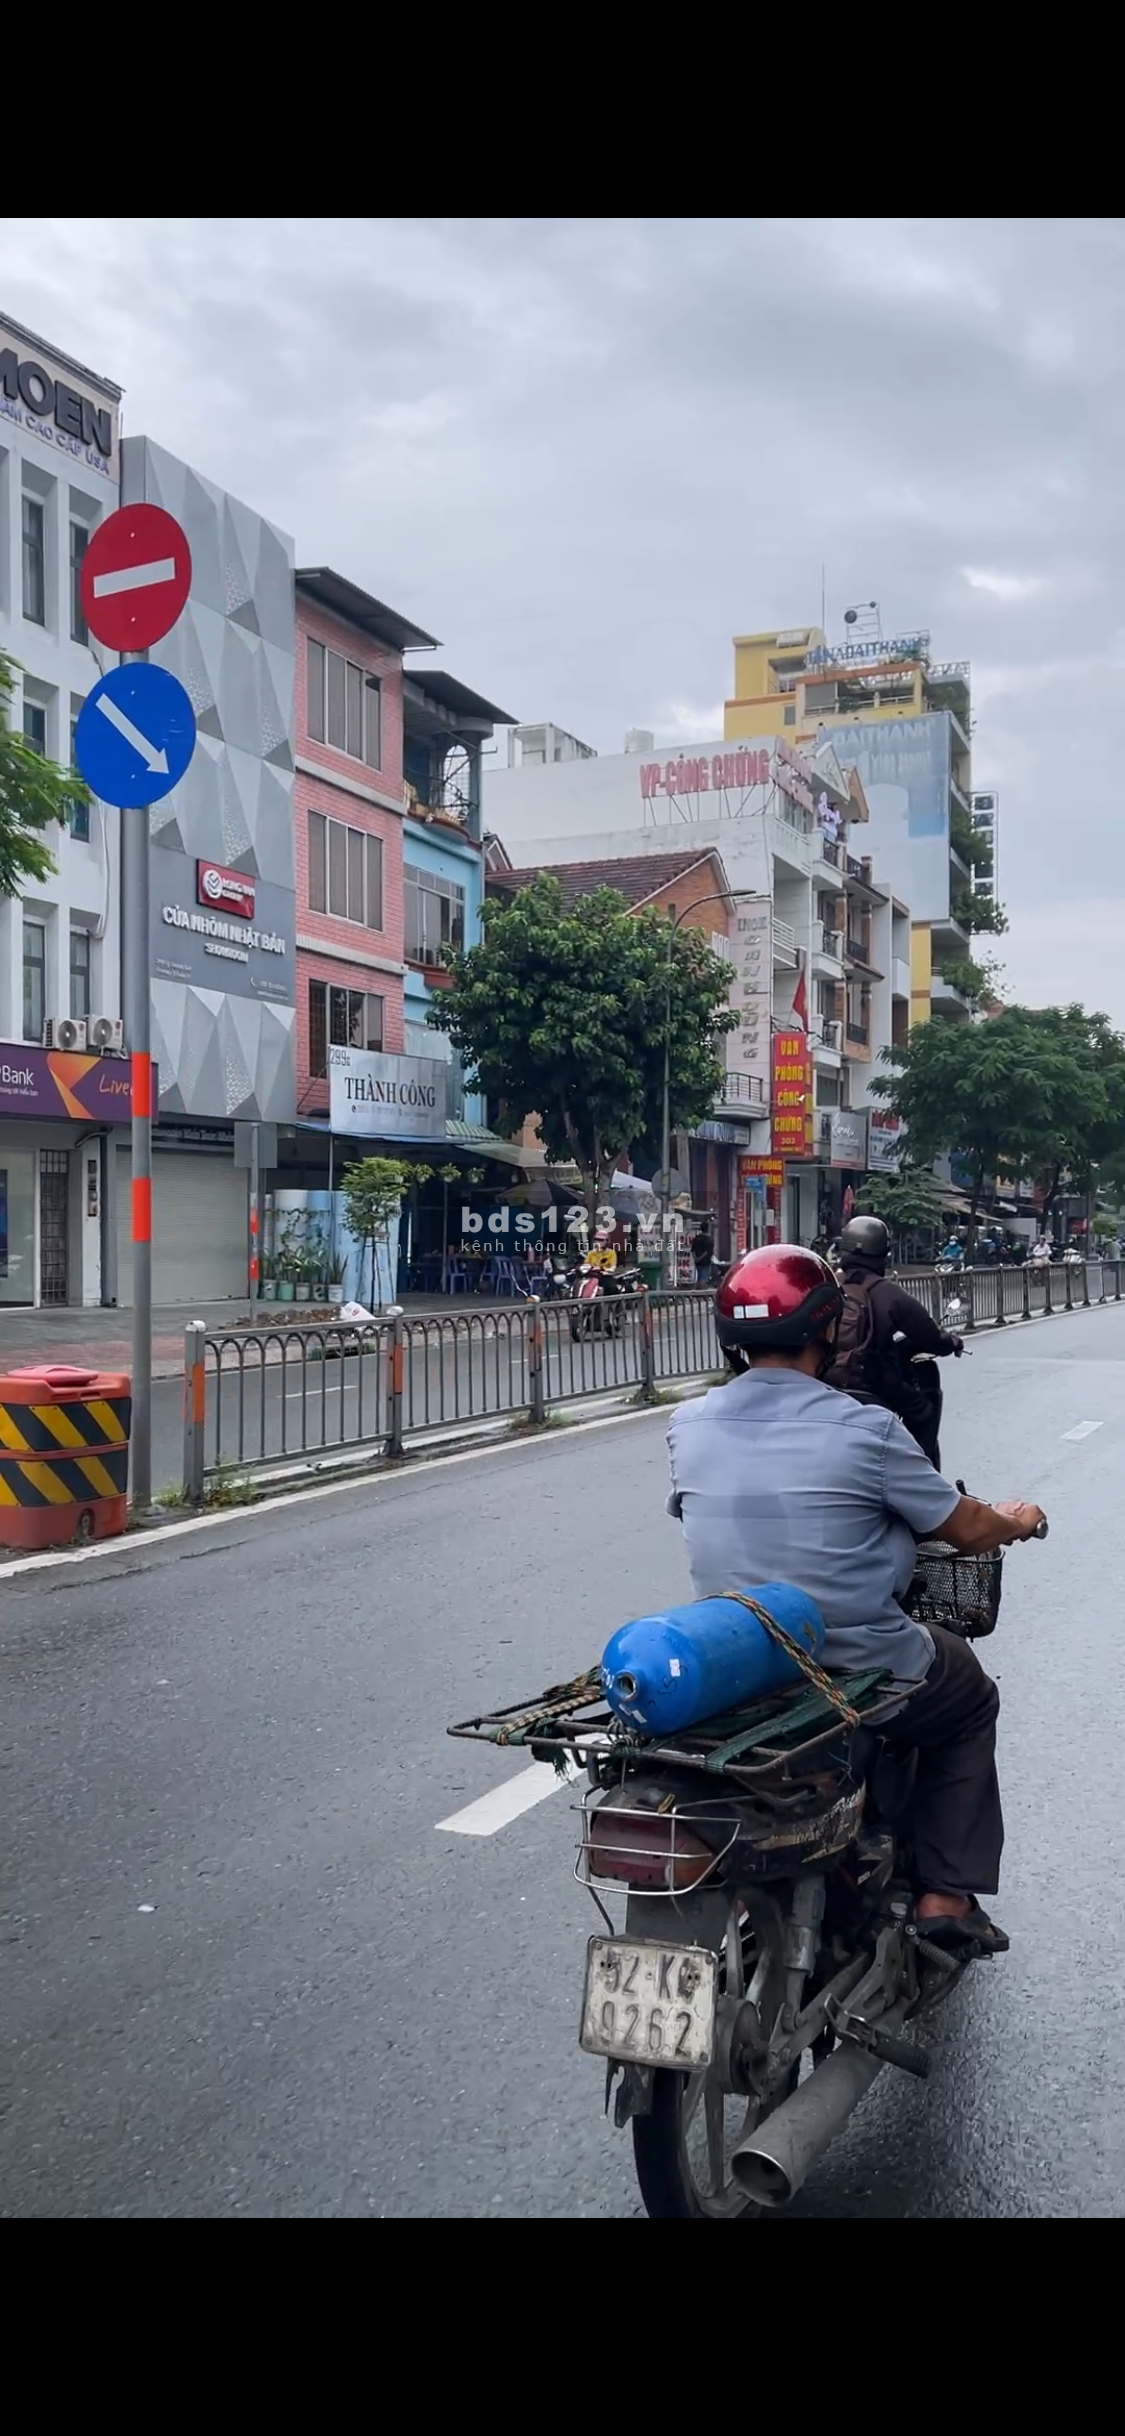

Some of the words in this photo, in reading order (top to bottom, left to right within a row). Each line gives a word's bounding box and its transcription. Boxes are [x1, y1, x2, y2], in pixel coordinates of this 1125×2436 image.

[25, 415, 53, 440] CAO
[85, 450, 110, 475] USA
[0, 1064, 34, 1086] Bank
[775, 1064, 804, 1082] PHÒNG
[344, 1073, 397, 1104] THÀNH
[399, 1078, 436, 1108] CÔNG
[777, 1087, 800, 1107] CÔNG
[600, 2000, 694, 2058] 9262
